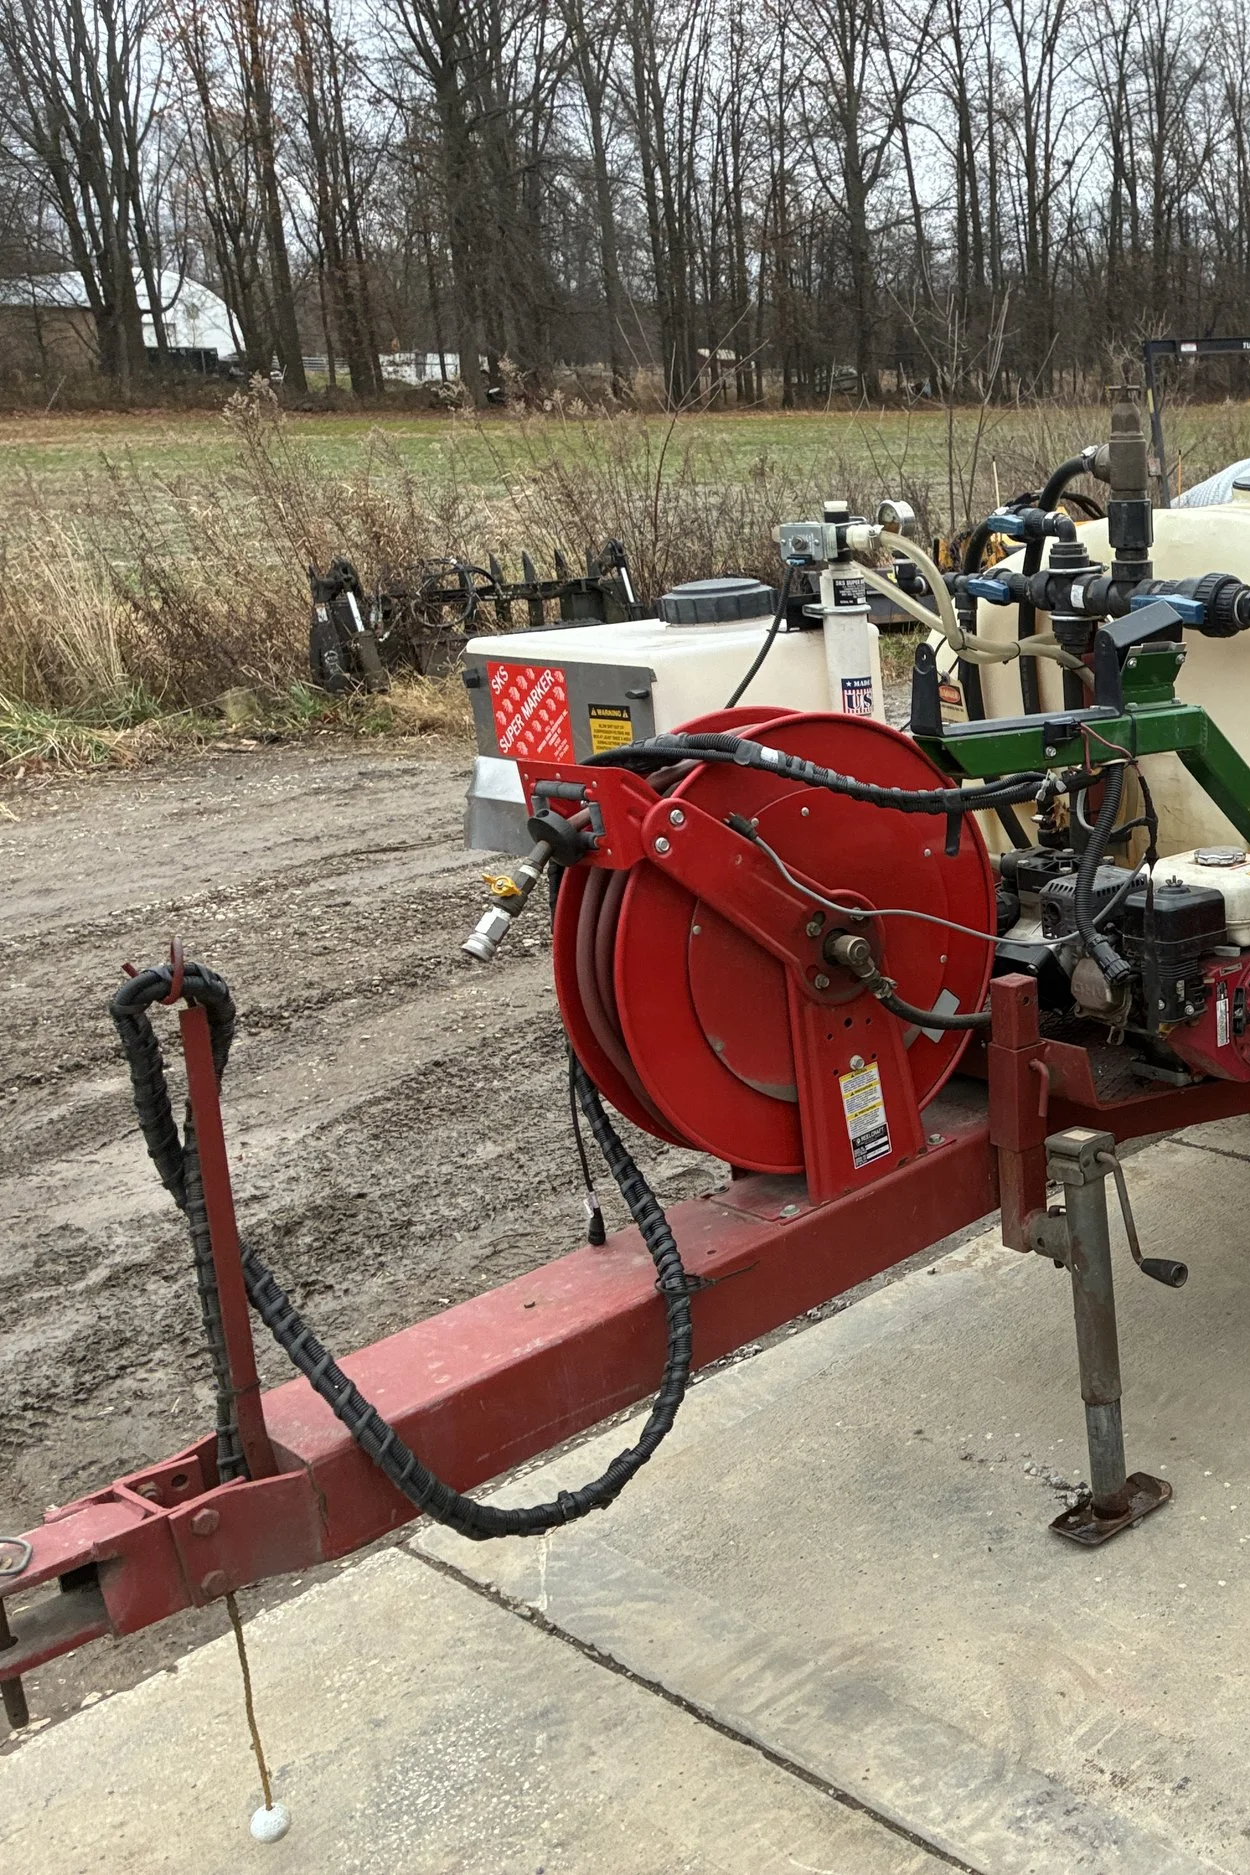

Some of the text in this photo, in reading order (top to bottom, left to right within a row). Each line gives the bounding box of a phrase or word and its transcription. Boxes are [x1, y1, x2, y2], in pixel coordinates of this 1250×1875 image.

[491, 665, 509, 695] SKS
[499, 713, 525, 754] SUPER
[520, 669, 555, 721] MARKER
